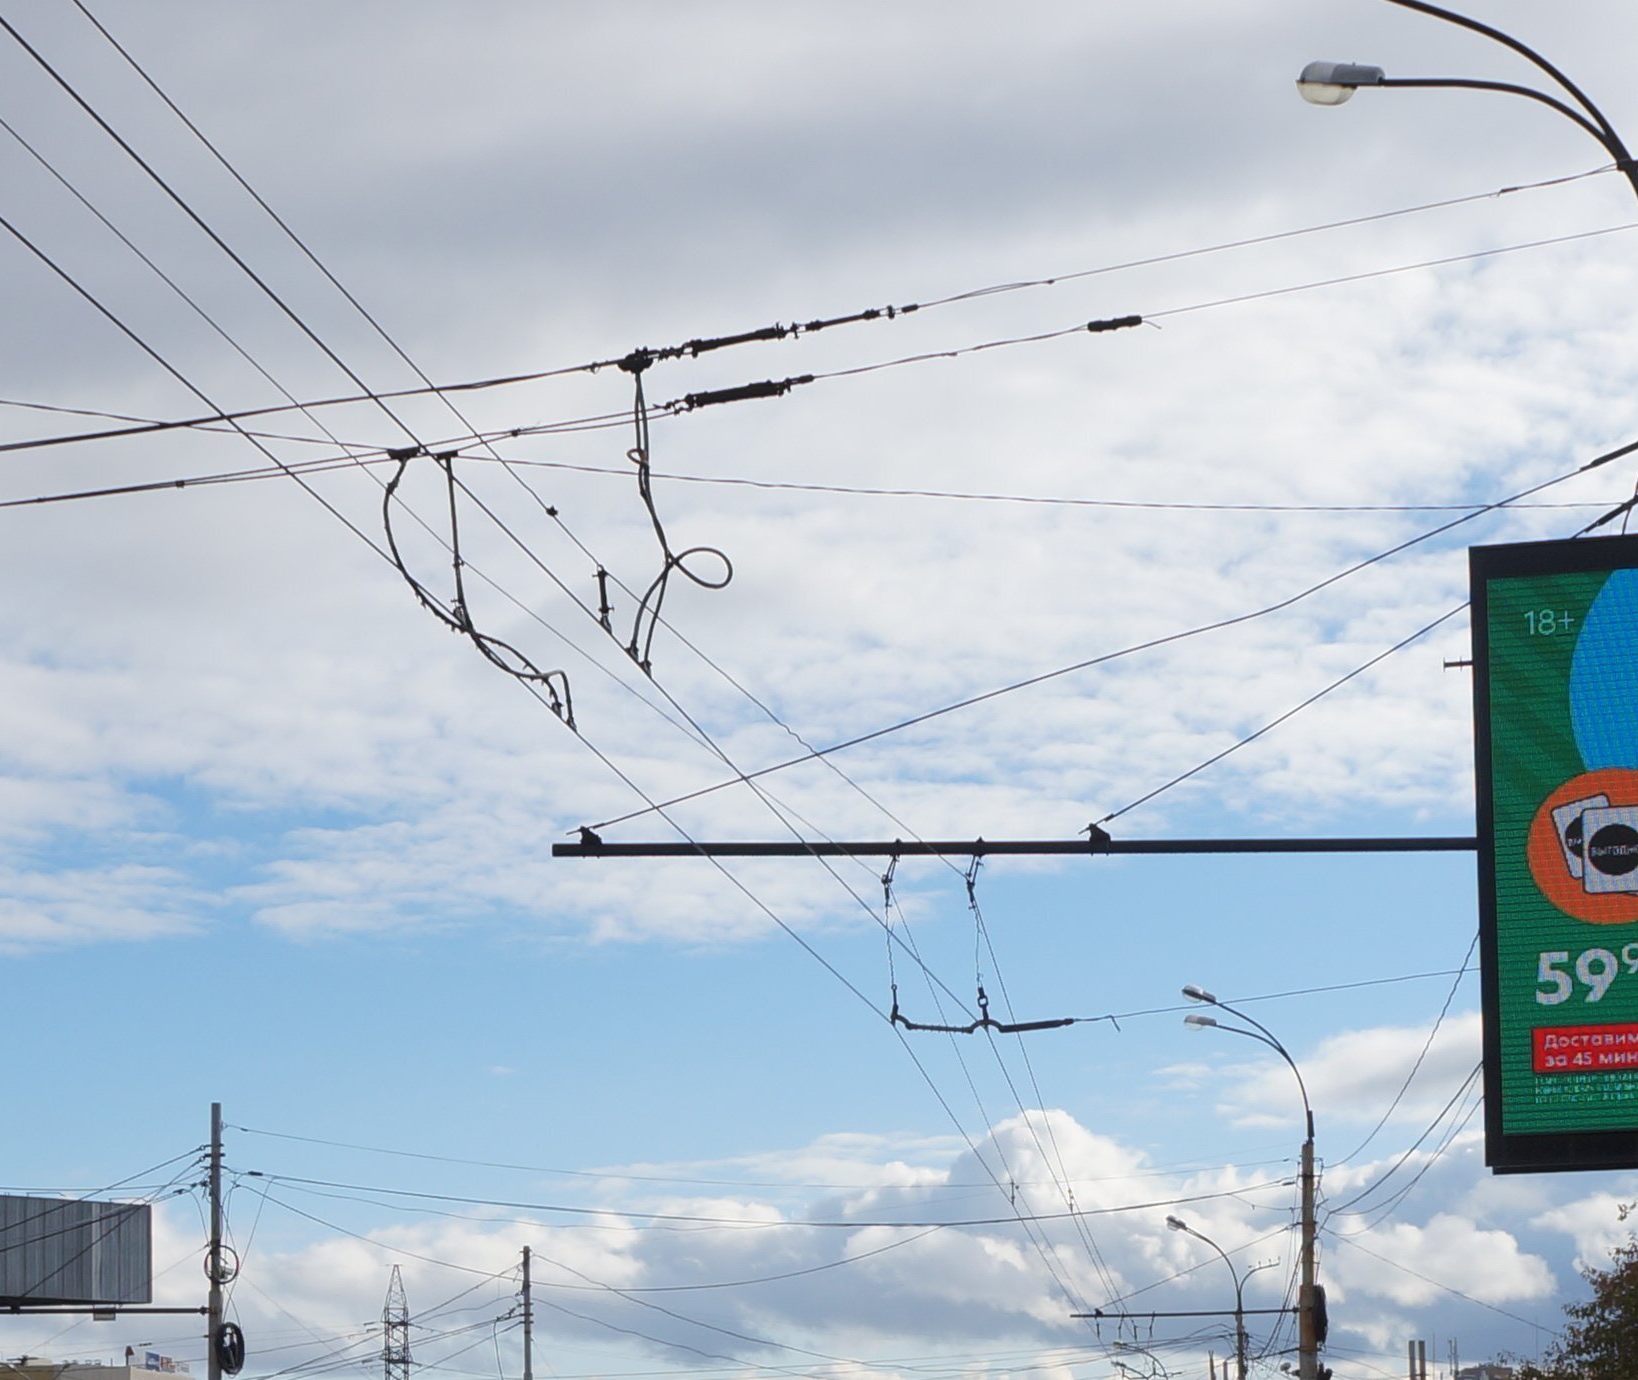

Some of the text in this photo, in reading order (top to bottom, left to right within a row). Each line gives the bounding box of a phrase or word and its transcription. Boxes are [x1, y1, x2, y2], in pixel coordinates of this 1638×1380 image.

[1524, 609, 1575, 636] 18+
[1544, 1054, 1568, 1068] за
[1572, 1051, 1593, 1066] 45
